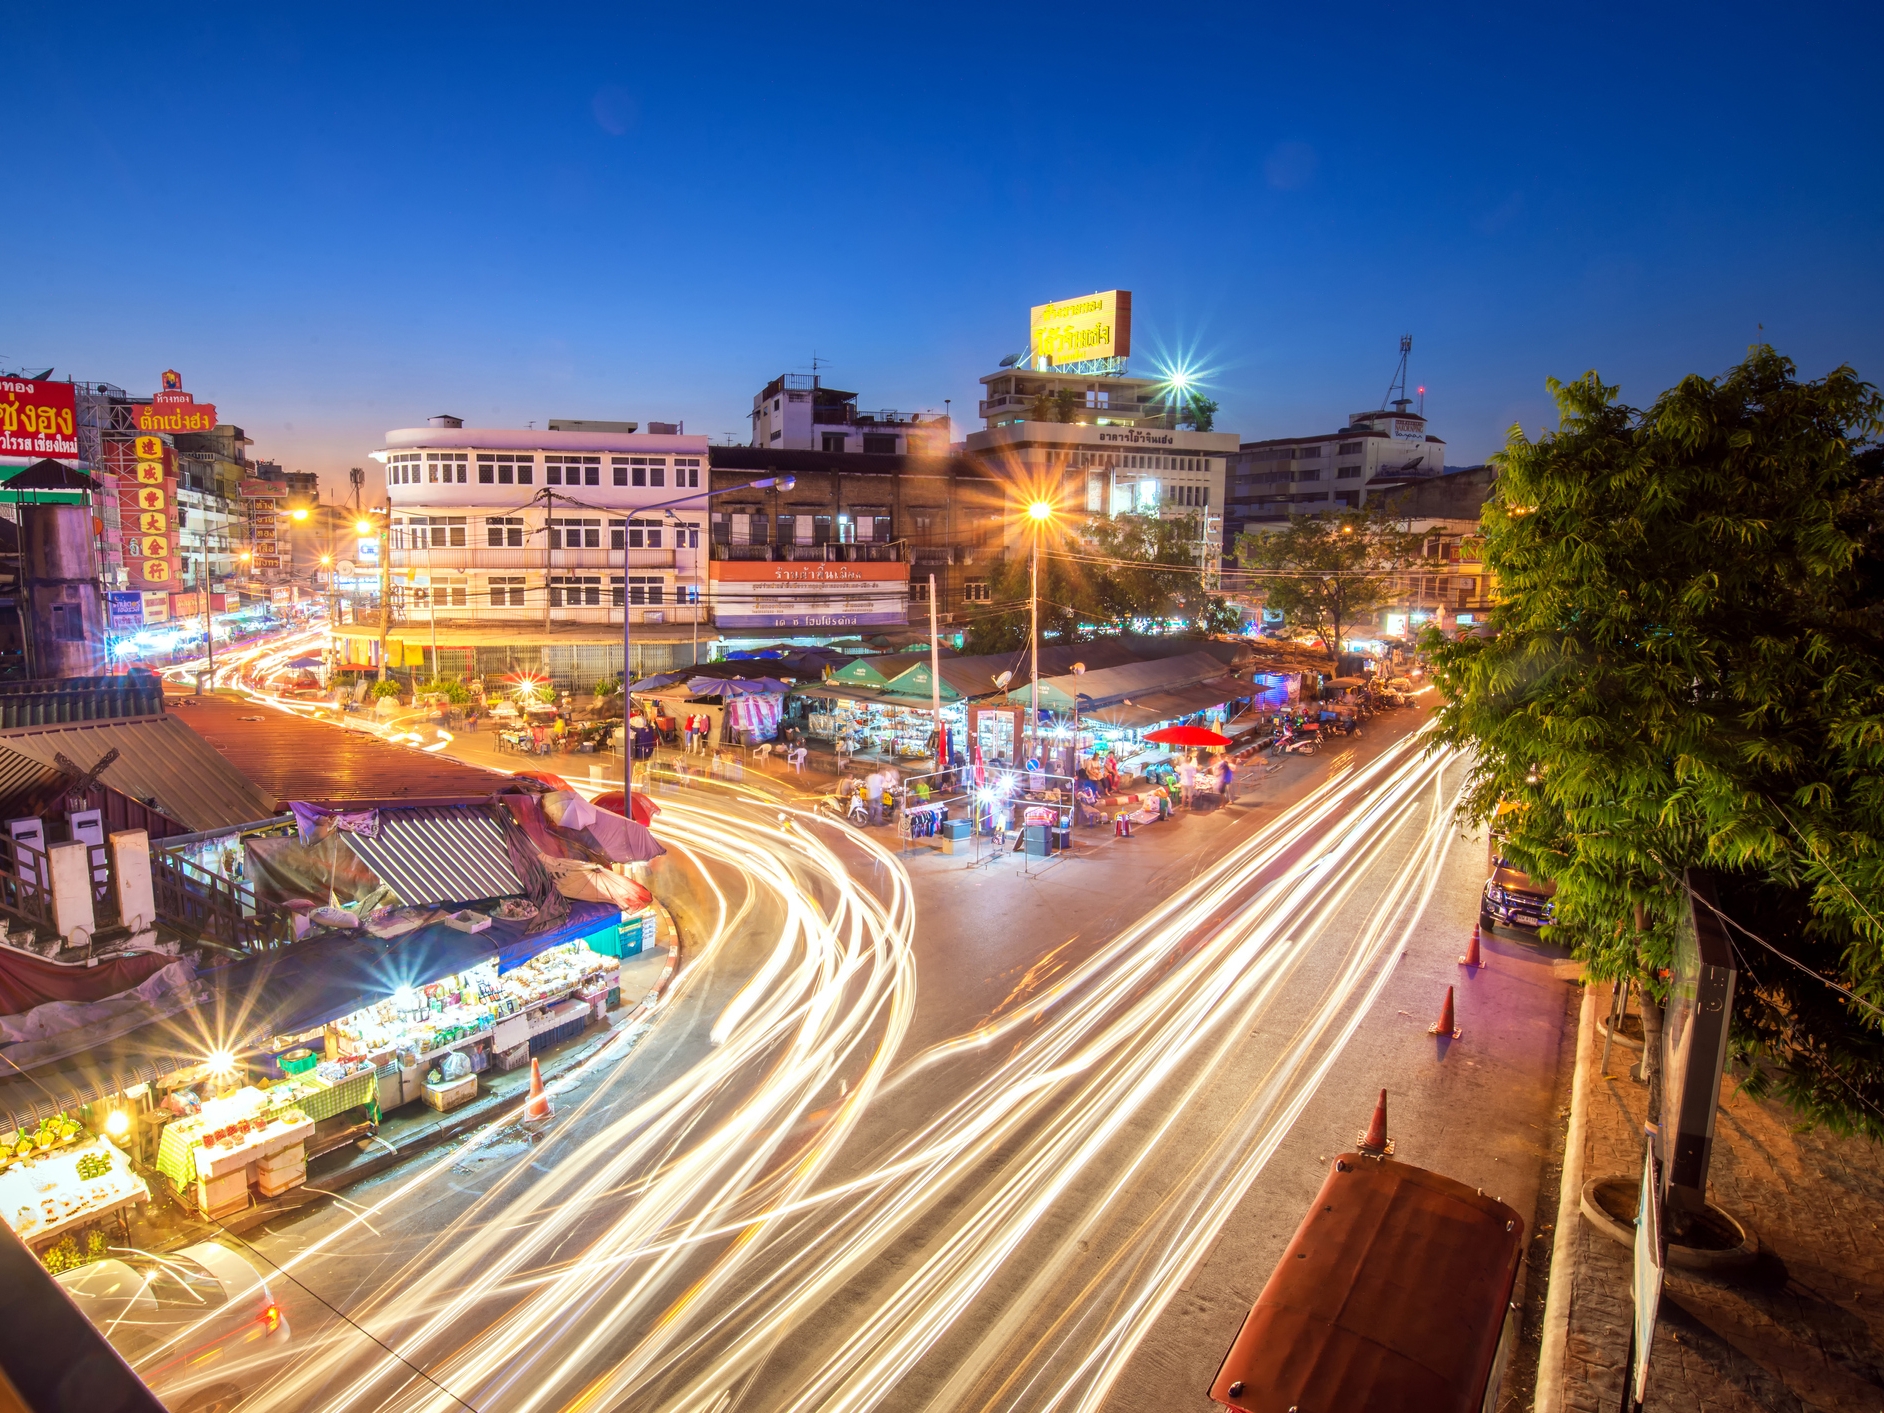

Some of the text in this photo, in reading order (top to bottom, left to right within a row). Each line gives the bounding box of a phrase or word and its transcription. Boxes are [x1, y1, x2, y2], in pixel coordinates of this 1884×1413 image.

[0, 380, 35, 394] ทอง
[156, 393, 190, 403] ห้างทอง
[140, 406, 210, 430] ตั๊กเซ่งฮง
[35, 432, 78, 454] เชียงใหม่
